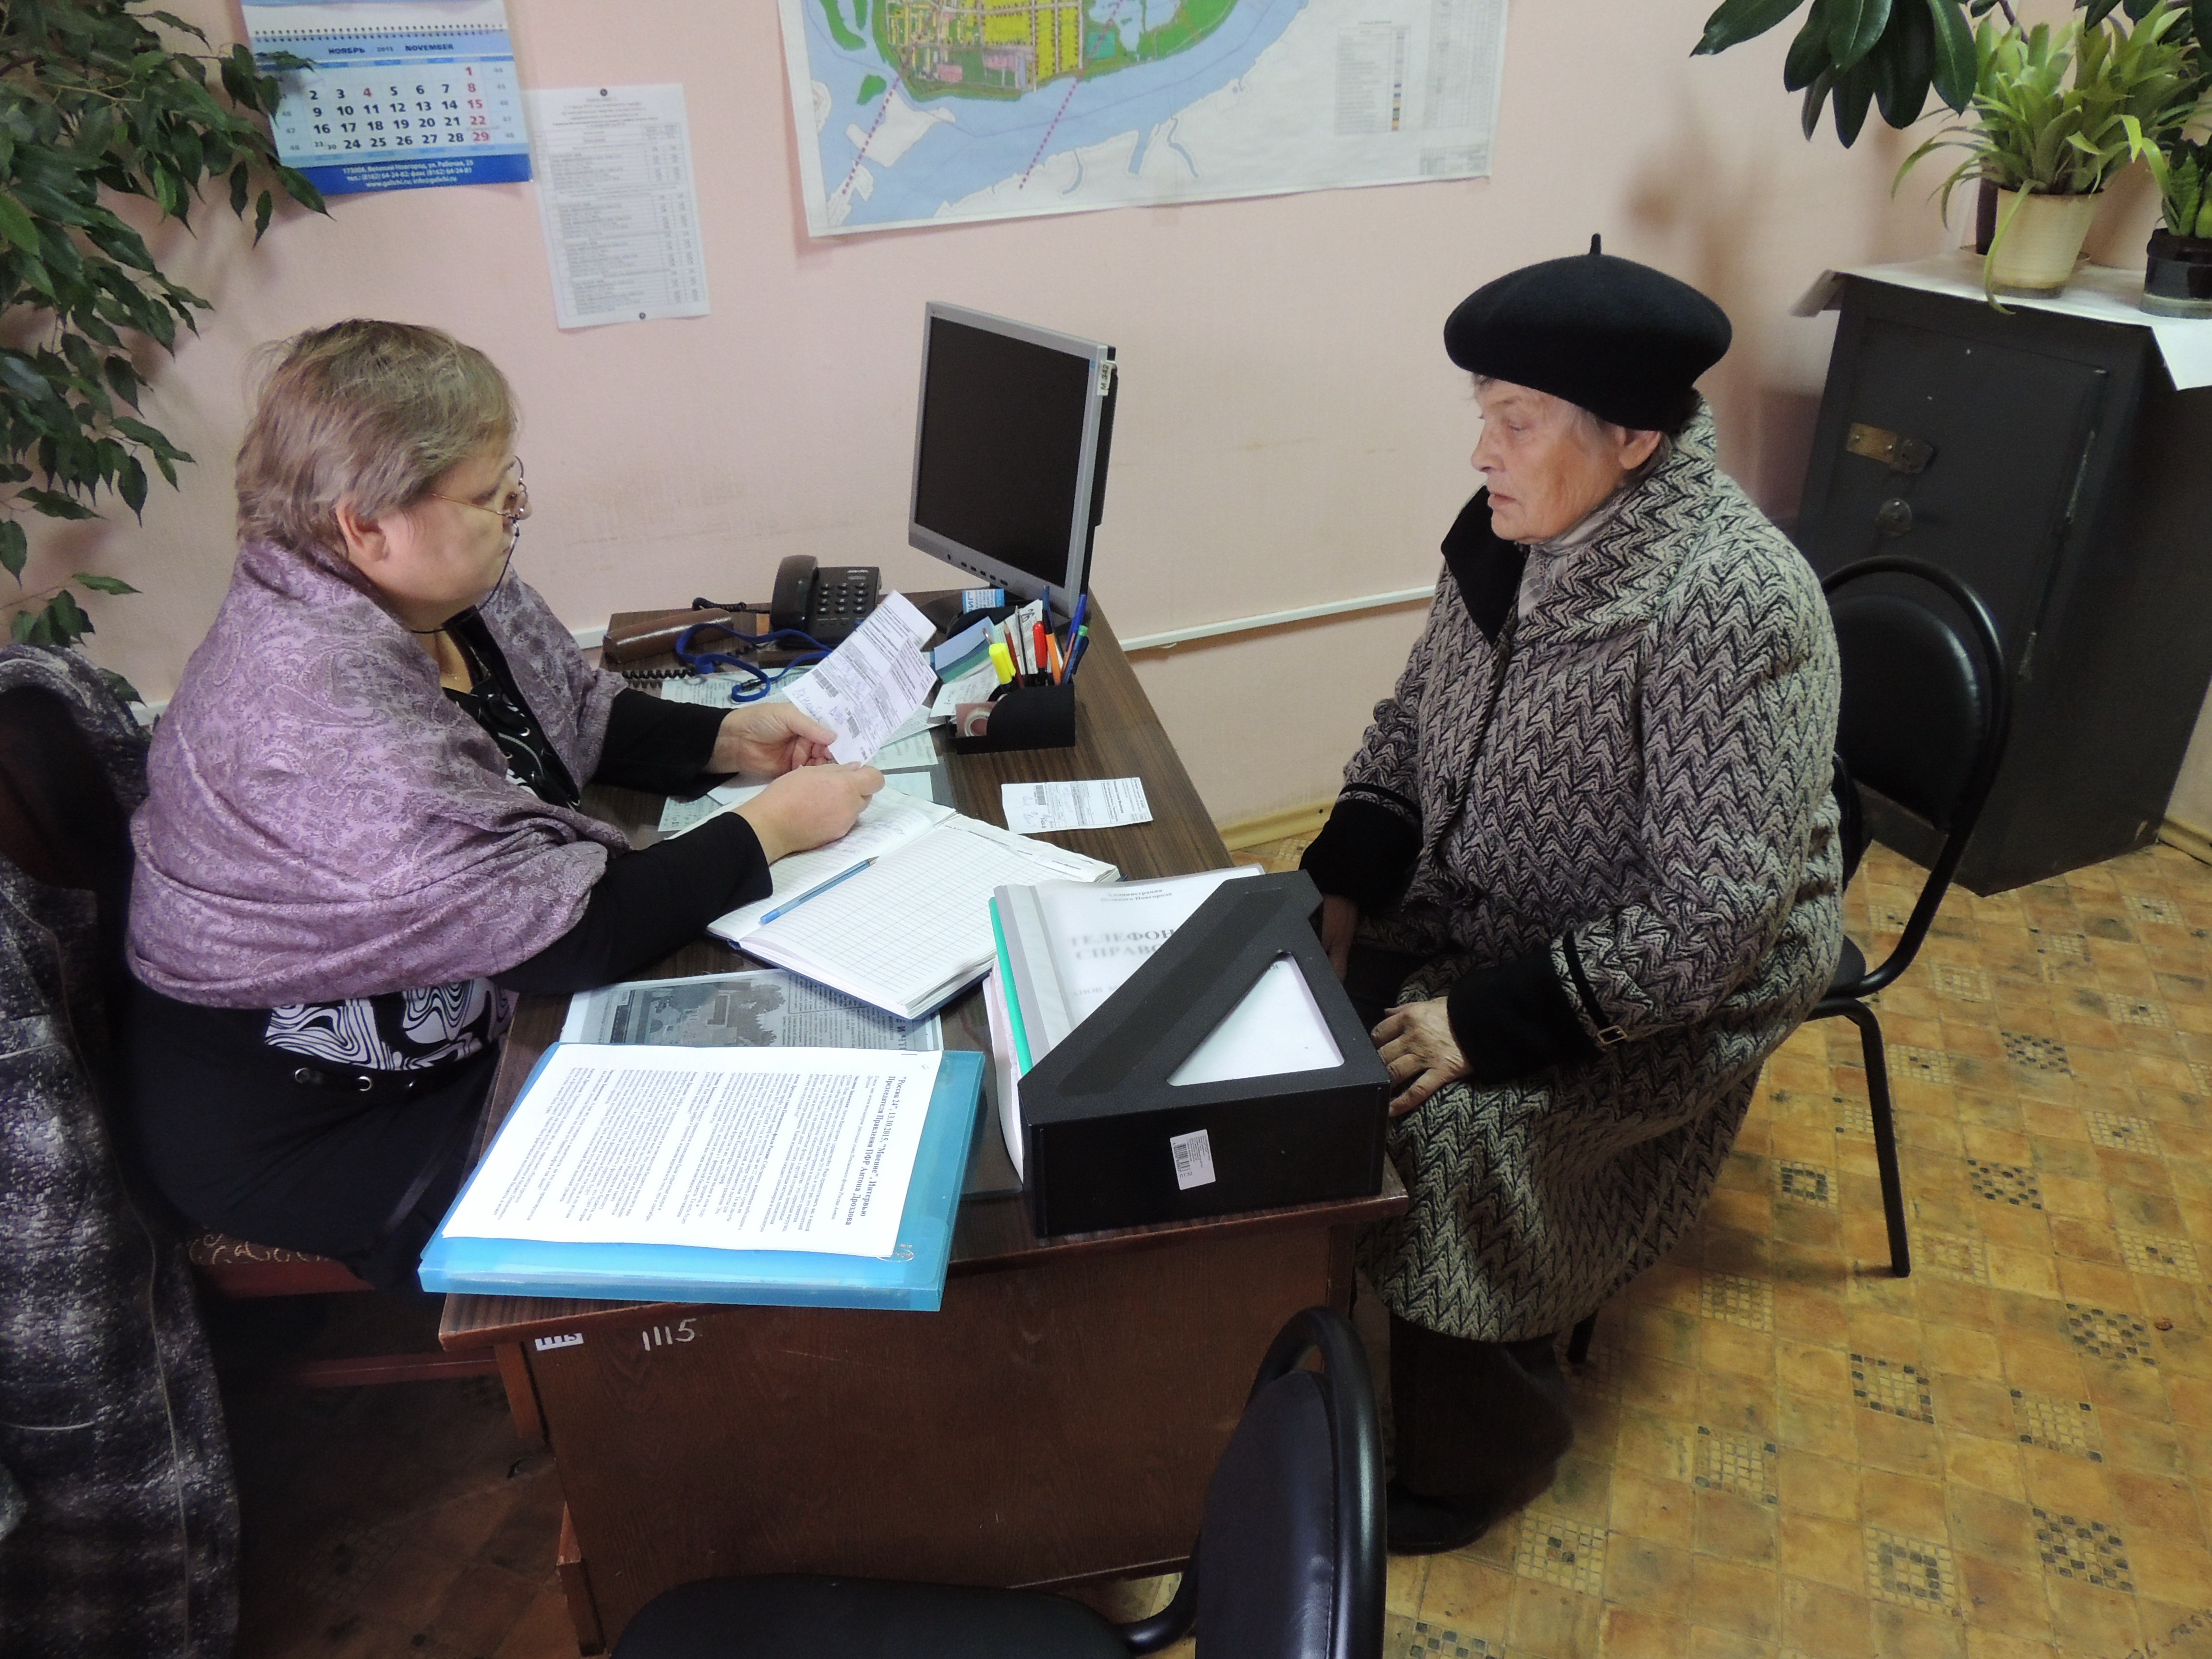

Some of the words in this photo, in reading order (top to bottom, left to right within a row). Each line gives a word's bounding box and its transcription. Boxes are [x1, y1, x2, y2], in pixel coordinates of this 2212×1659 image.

[466, 67, 472, 76] 1
[310, 90, 318, 100] 2
[336, 89, 345, 99] 3
[363, 87, 372, 97] 4
[390, 86, 398, 96] 5
[416, 84, 424, 95] 6
[442, 84, 449, 93] 7
[468, 83, 476, 92] 8
[313, 108, 323, 117] 9
[337, 106, 354, 116] 10
[363, 104, 379, 114] 11
[389, 103, 406, 112] 12
[416, 101, 432, 111] 13
[442, 100, 458, 110] 14
[468, 99, 483, 108] 15
[313, 124, 331, 134] 16
[340, 122, 356, 132] 17
[367, 121, 384, 131] 18
[393, 119, 409, 129] 19
[419, 118, 435, 128] 20
[444, 117, 460, 126] 21
[470, 115, 486, 125] 22
[343, 139, 361, 149] 24
[370, 137, 386, 147] 25
[396, 135, 413, 145] 26
[421, 134, 437, 144] 27
[447, 132, 464, 142] 28
[473, 132, 489, 141] 29
[878, 1076, 896, 1114] Председателя
[893, 1076, 907, 1098] "Россия
[867, 1115, 884, 1148] Правления
[879, 1112, 896, 1142] 13.10.2015,
[862, 1149, 874, 1166] ПФР
[869, 1144, 887, 1179] "Мнение",
[854, 1166, 868, 1192] Антона
[845, 1193, 861, 1226] Дроздова
[860, 1181, 877, 1217] Интервью
[642, 1318, 697, 1351] 1115
